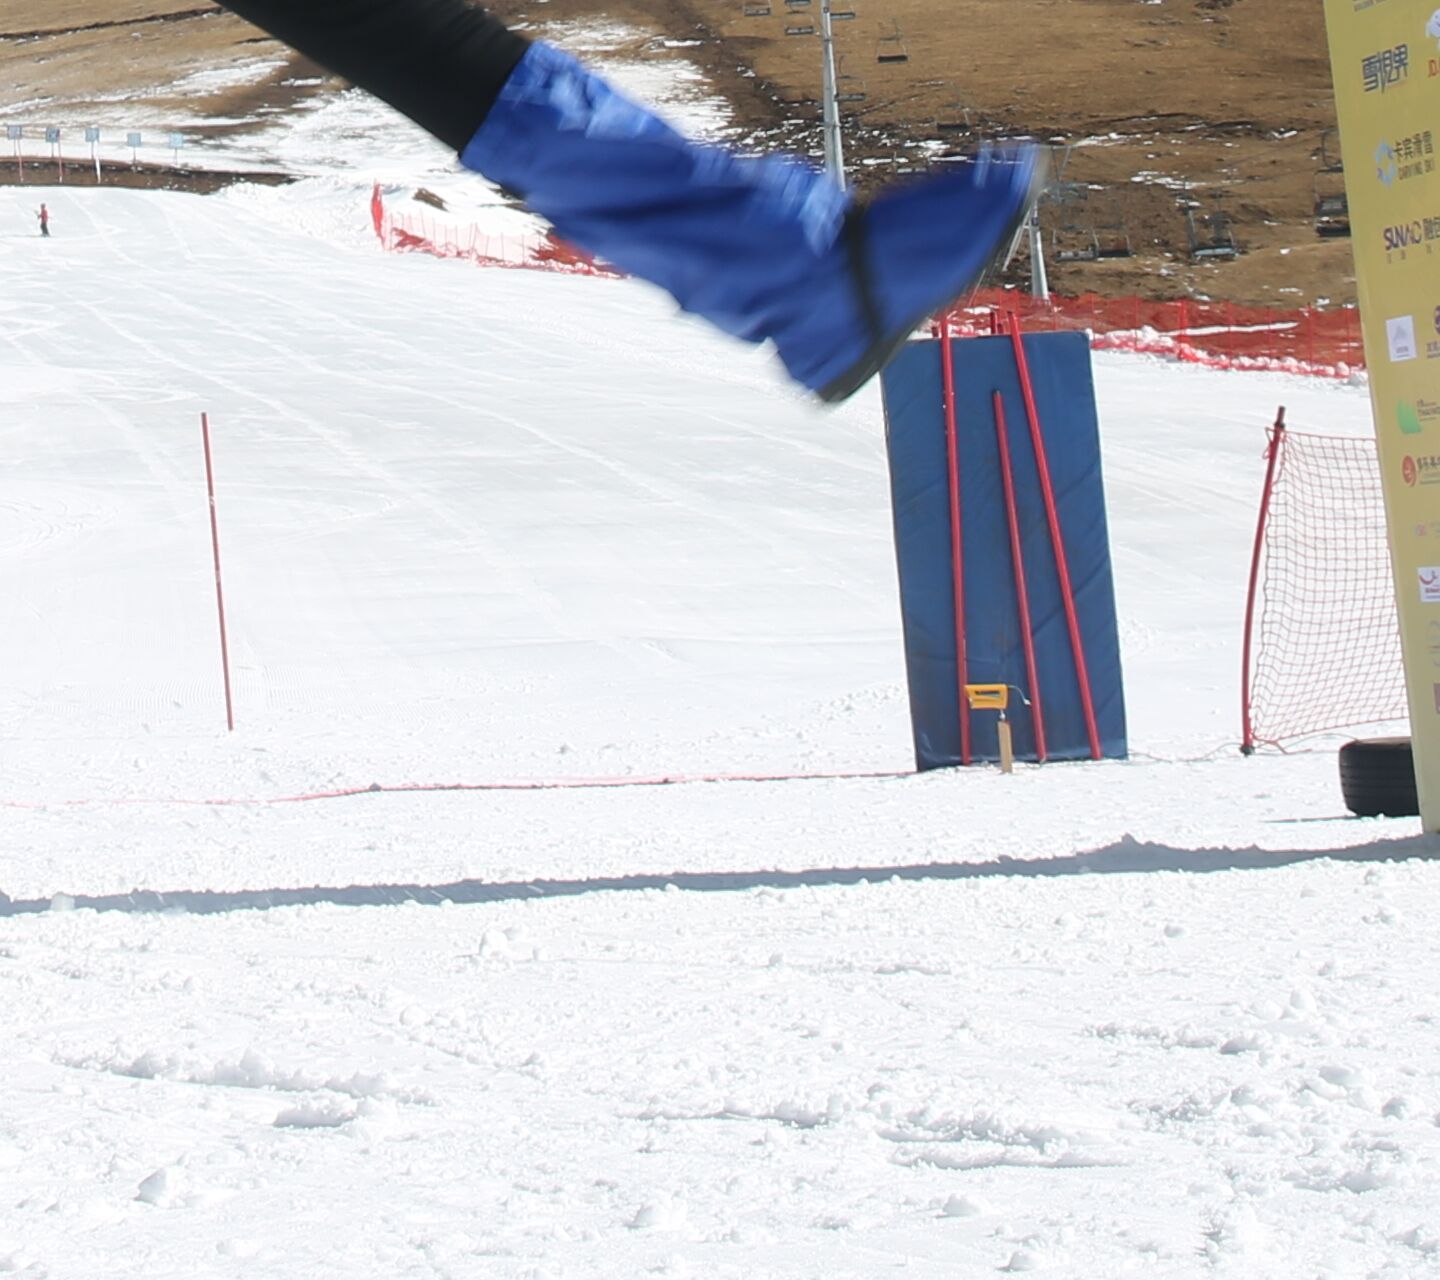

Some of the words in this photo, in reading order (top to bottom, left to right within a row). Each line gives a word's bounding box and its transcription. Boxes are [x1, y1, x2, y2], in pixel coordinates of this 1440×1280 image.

[1392, 130, 1433, 164] 卡宾滑雪
[1383, 219, 1422, 251] SUNAC
